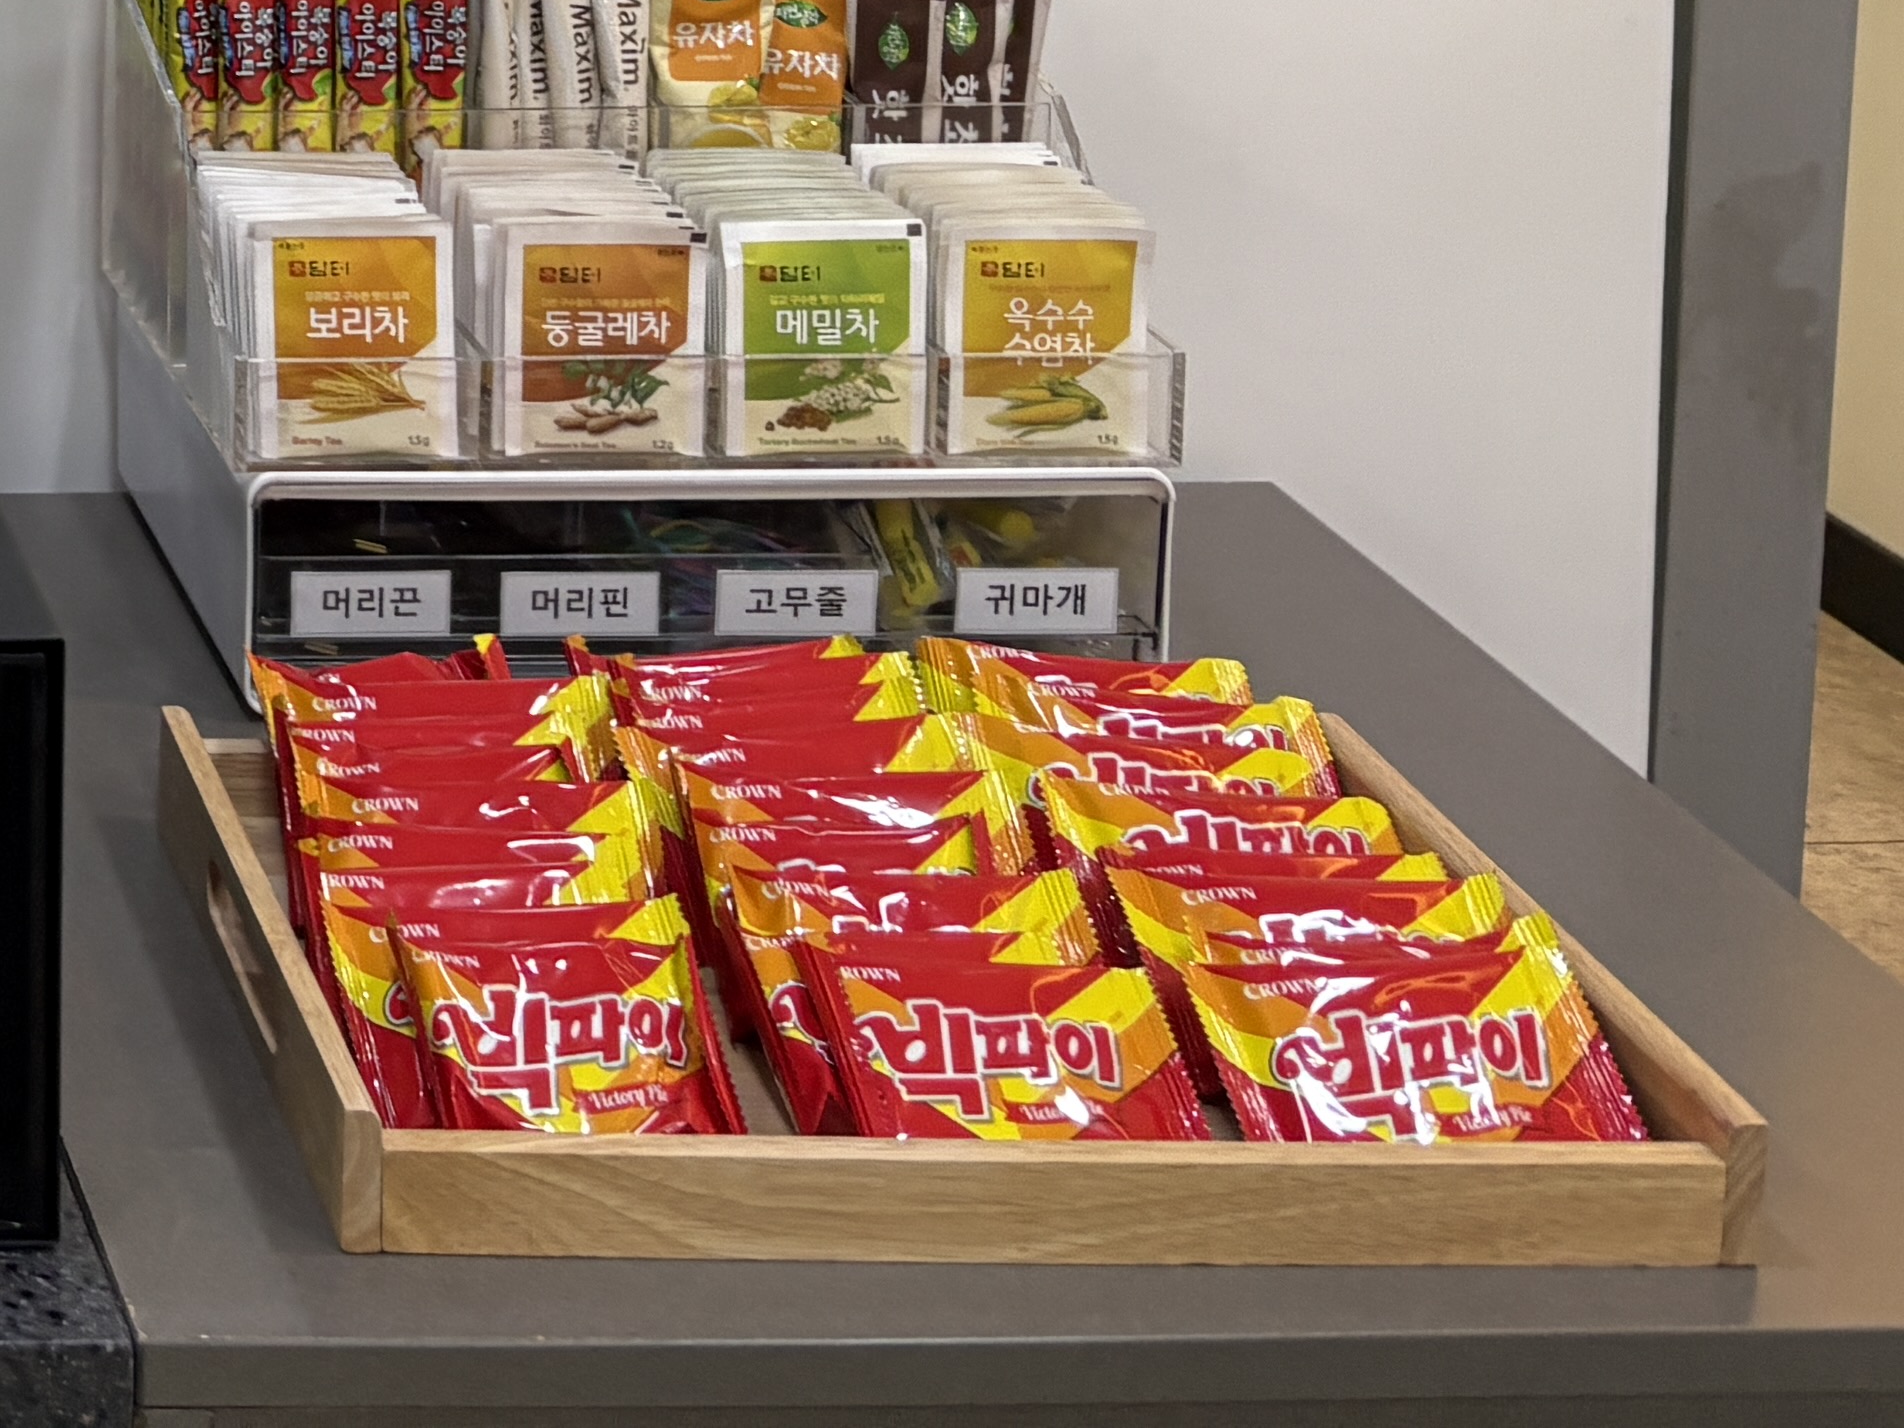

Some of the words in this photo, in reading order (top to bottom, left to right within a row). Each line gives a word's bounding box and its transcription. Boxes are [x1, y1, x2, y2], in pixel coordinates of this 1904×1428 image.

[234, 1, 255, 76] 아이스티
[290, 0, 308, 74] 아이스티
[354, 2, 376, 78] 아이스티
[424, 0, 445, 72] 아이스티
[673, 20, 755, 48] 유자차
[306, 306, 409, 343] 보리차
[542, 311, 671, 347] 둥굴레차
[776, 308, 879, 345] 메밀차
[1004, 297, 1094, 332] 옥수수
[1003, 332, 1095, 367] 수염차
[321, 586, 423, 620] 머리끈
[530, 584, 630, 620] 머리핀
[744, 584, 849, 619] 고무줄
[984, 583, 1088, 617] 귀마개
[312, 696, 377, 711] CROWN
[352, 797, 419, 814] CROWN
[710, 784, 782, 800] CROWN
[328, 836, 393, 852] CROWN
[709, 827, 776, 844] CROWN
[760, 879, 829, 900] CROWN
[1181, 886, 1257, 904] CROWN
[839, 965, 901, 983] ROWN
[588, 1086, 646, 1110] Victory
